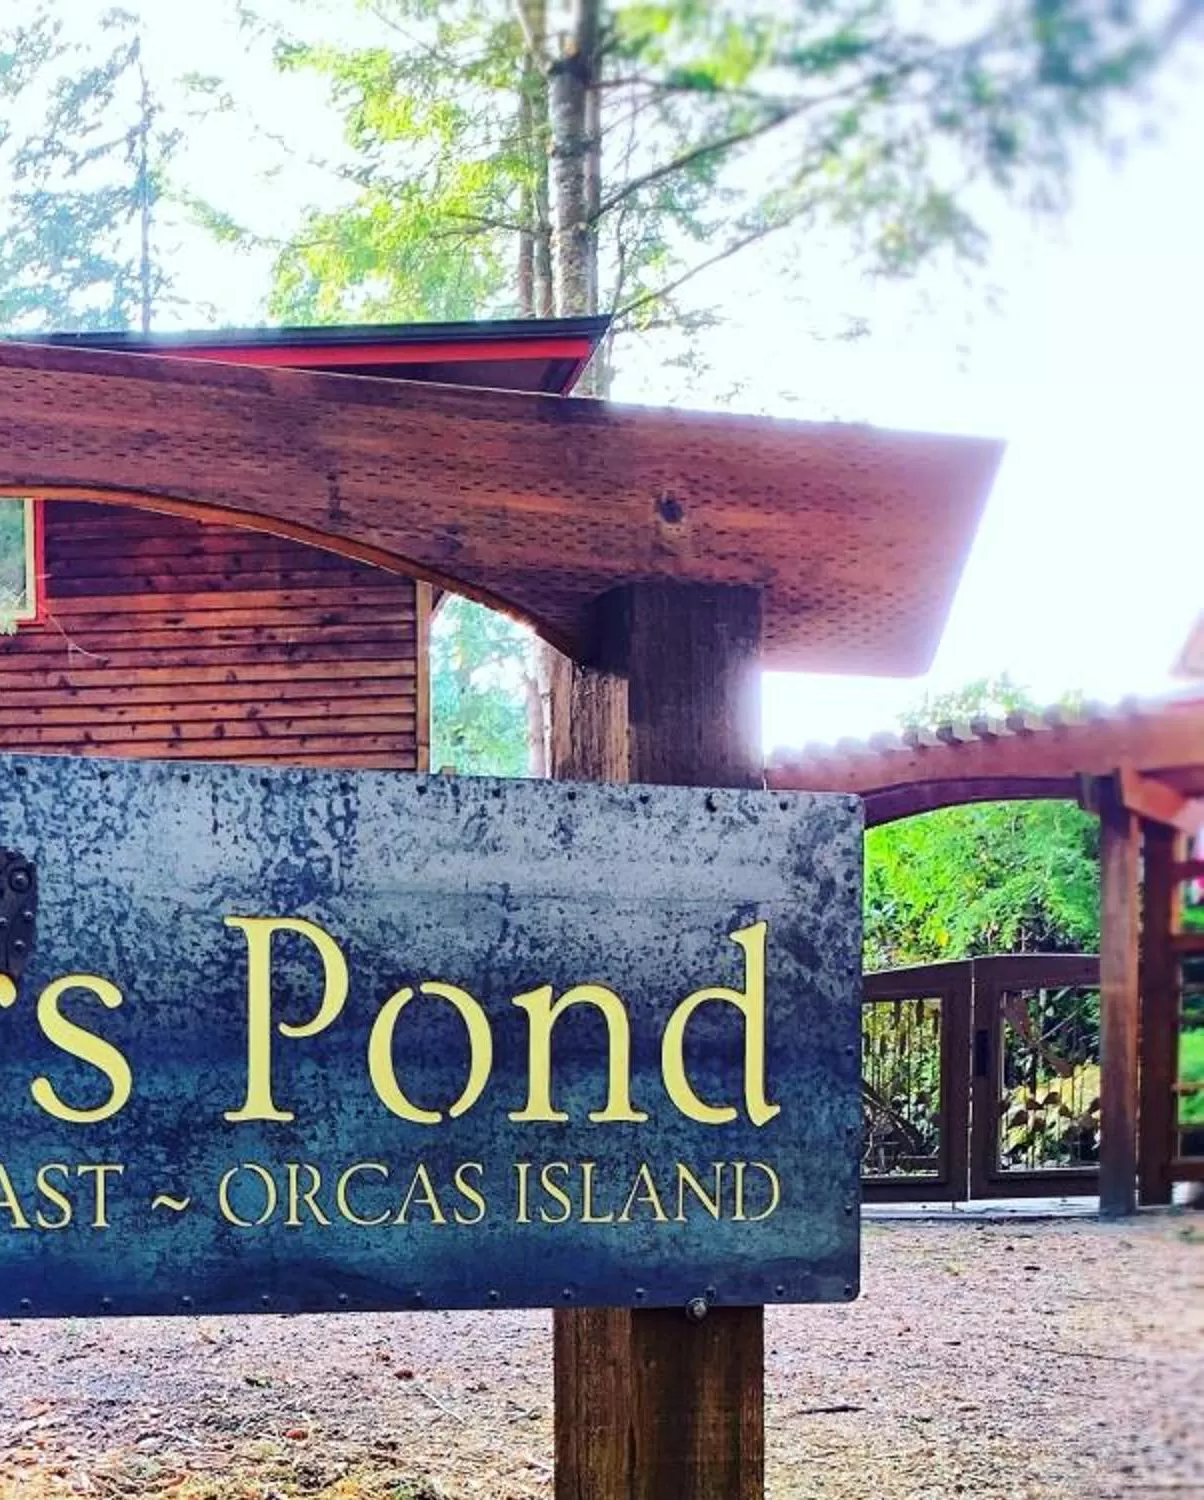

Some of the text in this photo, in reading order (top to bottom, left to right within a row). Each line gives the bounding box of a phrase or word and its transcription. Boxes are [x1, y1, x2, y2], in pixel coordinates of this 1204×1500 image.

[224, 915, 781, 1127] Pond
[218, 1161, 488, 1228] ORCAS
[514, 1159, 782, 1225] ISLAND
